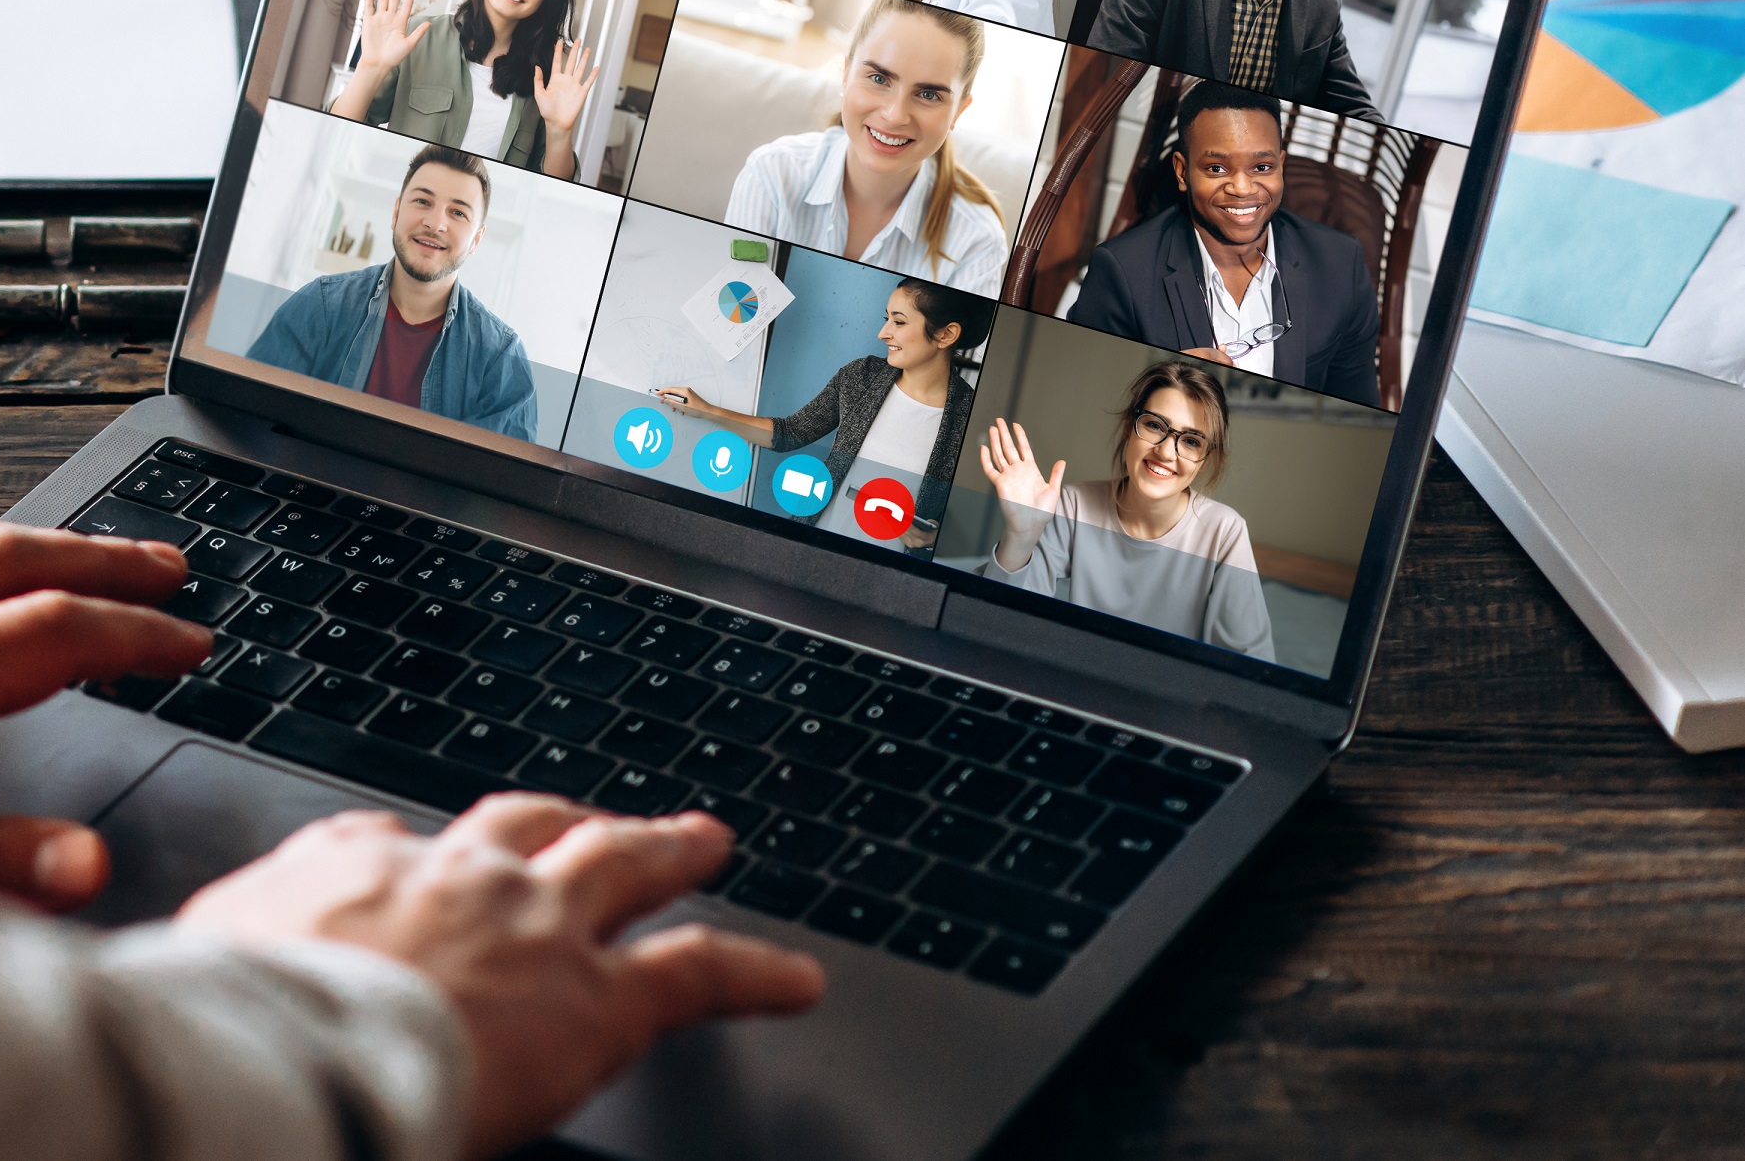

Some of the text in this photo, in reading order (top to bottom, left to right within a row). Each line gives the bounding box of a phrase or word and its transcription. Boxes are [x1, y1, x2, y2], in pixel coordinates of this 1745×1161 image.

[173, 449, 196, 460] esc
[205, 503, 216, 513] 1
[287, 511, 302, 521] @
[270, 523, 288, 535] 2
[209, 537, 226, 551] Q
[360, 534, 373, 542] #
[344, 546, 361, 557] 3
[280, 557, 305, 572] W
[433, 556, 446, 565] $
[417, 569, 433, 580] 4
[182, 580, 199, 594] A
[351, 580, 370, 594] E
[447, 577, 466, 590] %
[489, 590, 507, 603] 5
[255, 602, 274, 616] S
[424, 603, 443, 617] R
[563, 613, 581, 626] 6
[326, 624, 347, 638] D
[501, 626, 519, 639] T
[639, 636, 657, 648] 7
[247, 651, 270, 667] X
[400, 647, 419, 661] F
[576, 649, 594, 663] Y
[712, 659, 731, 672] 8
[321, 675, 342, 690] C
[475, 671, 496, 687] G
[648, 672, 670, 687] U
[399, 698, 418, 714] V
[549, 693, 573, 711] H
[624, 719, 645, 733] J
[544, 745, 569, 763] N
[700, 740, 722, 758] K
[876, 740, 897, 756] P
[619, 768, 648, 788] M
